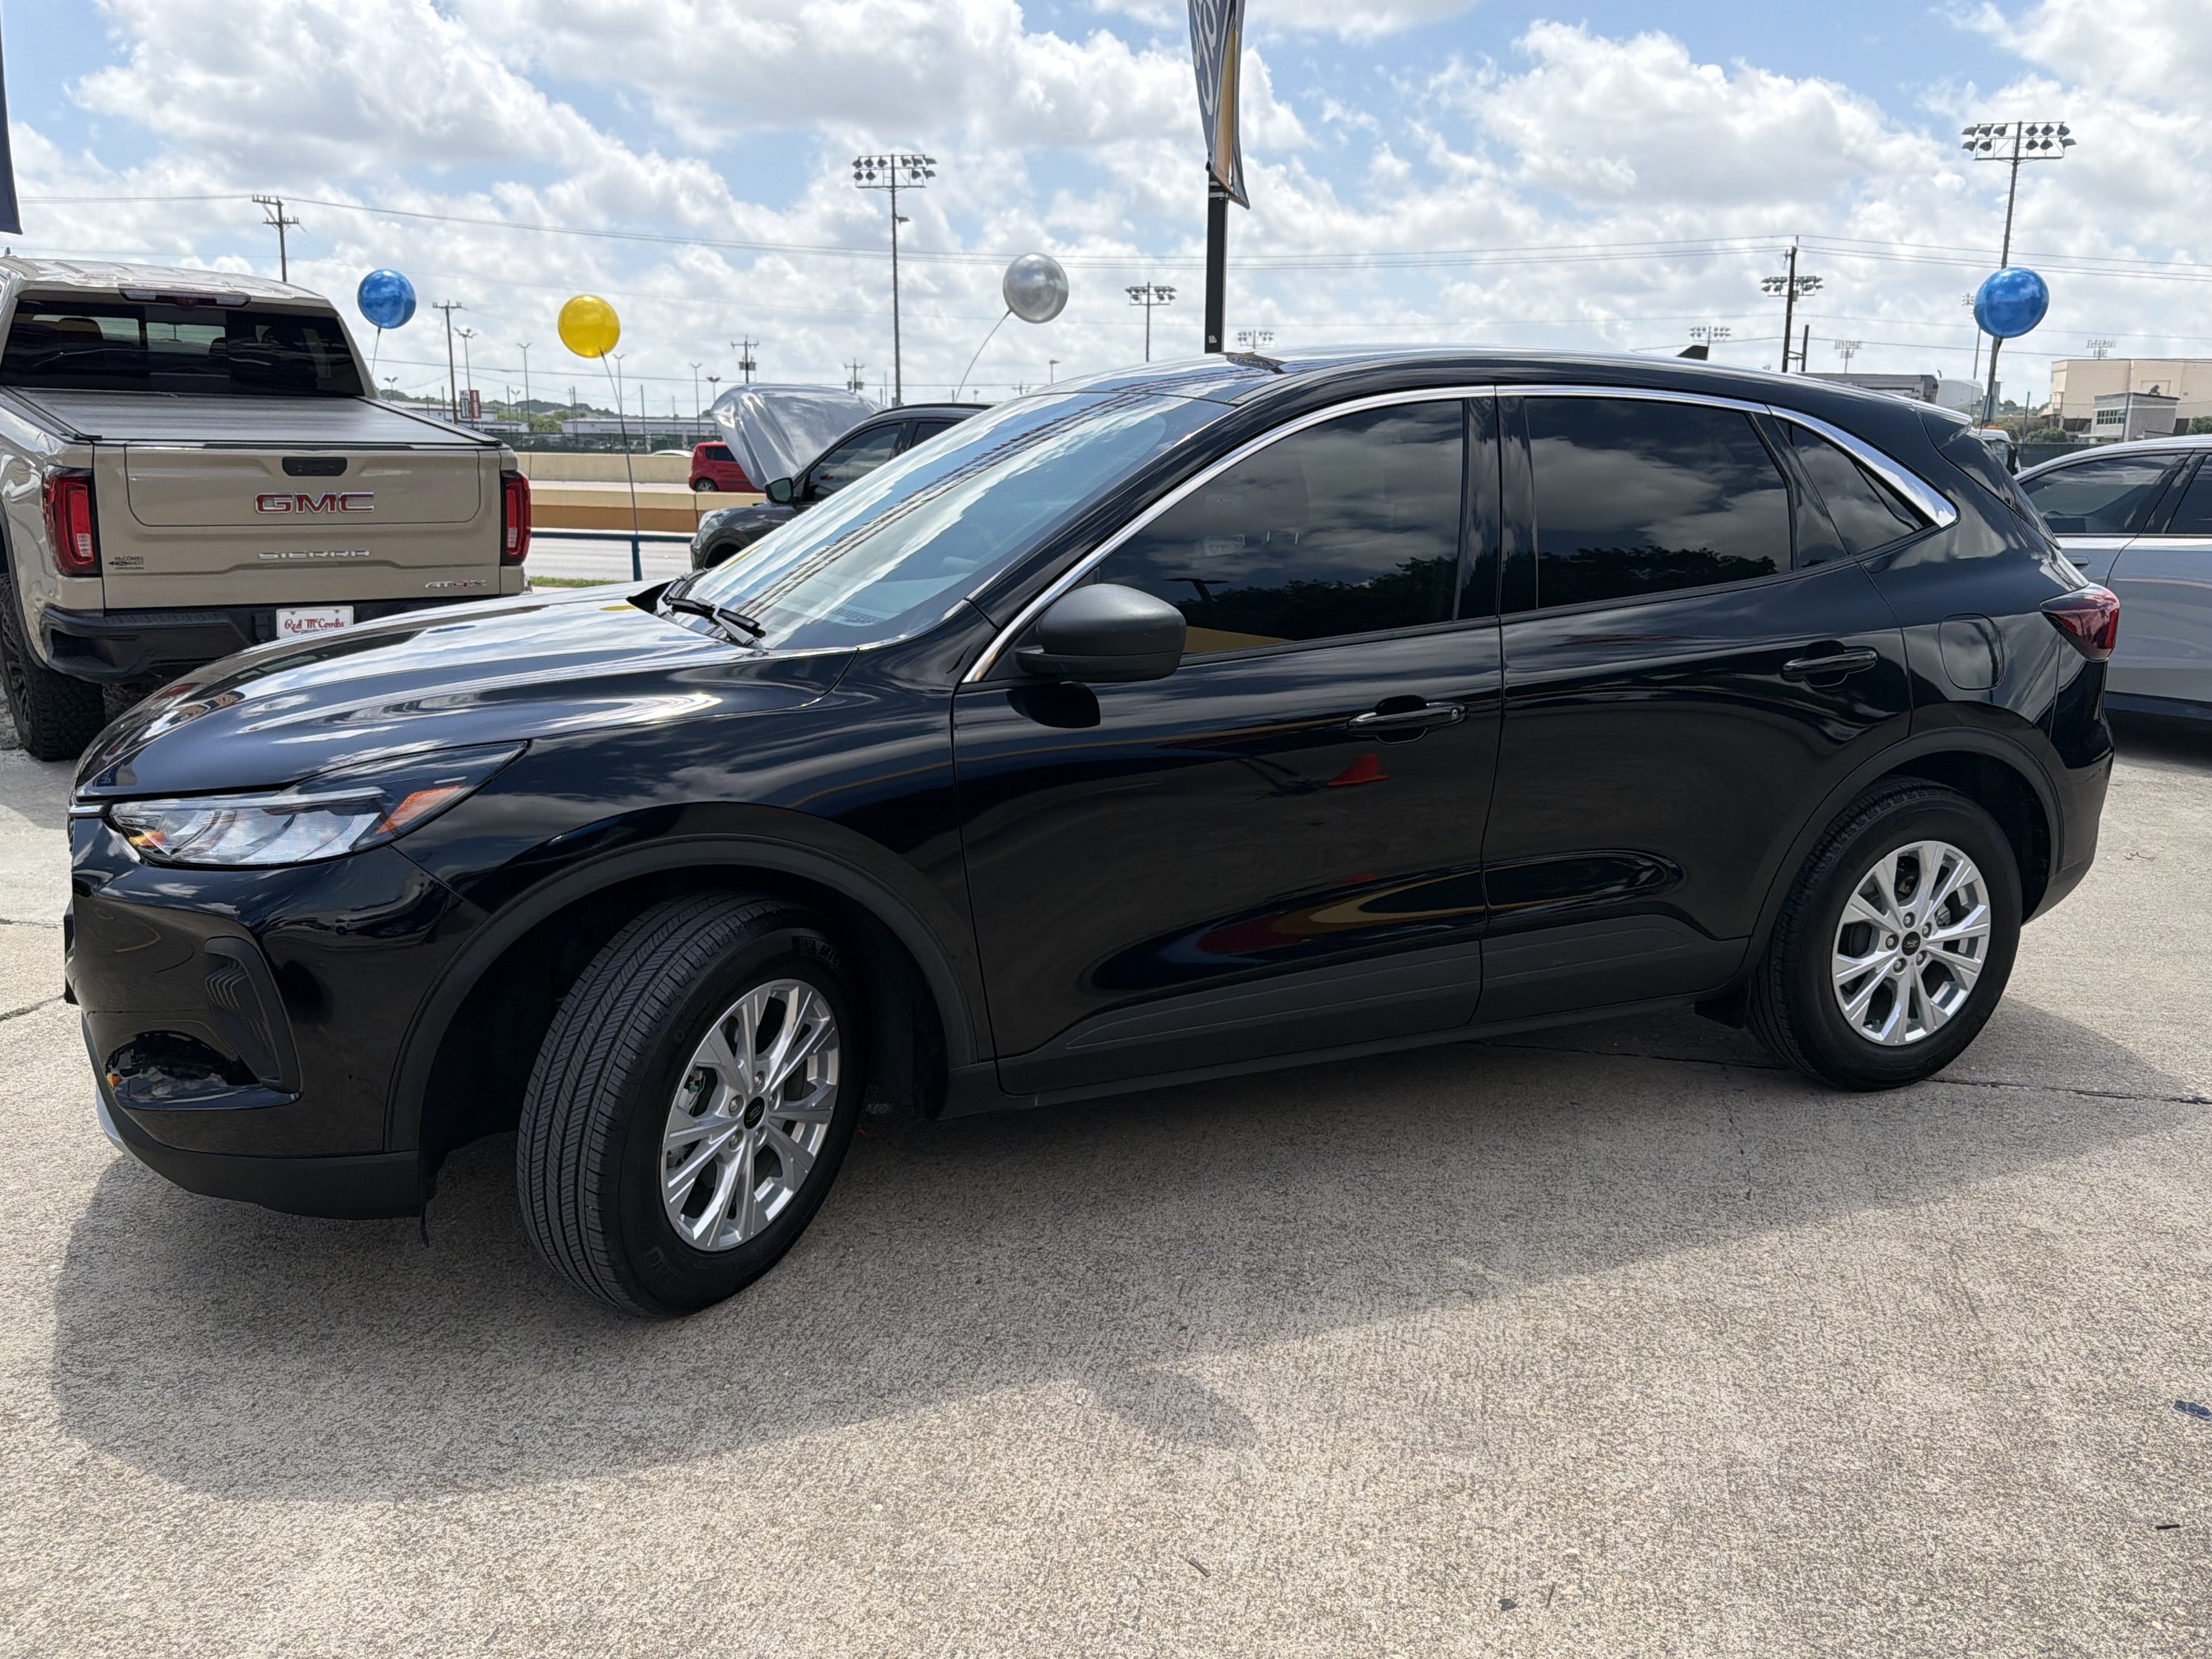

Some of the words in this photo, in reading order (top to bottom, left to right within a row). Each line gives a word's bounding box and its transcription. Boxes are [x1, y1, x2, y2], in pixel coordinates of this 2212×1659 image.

[255, 492, 375, 514] GMC
[259, 550, 370, 560] SIERRA
[285, 618, 302, 633] Red
